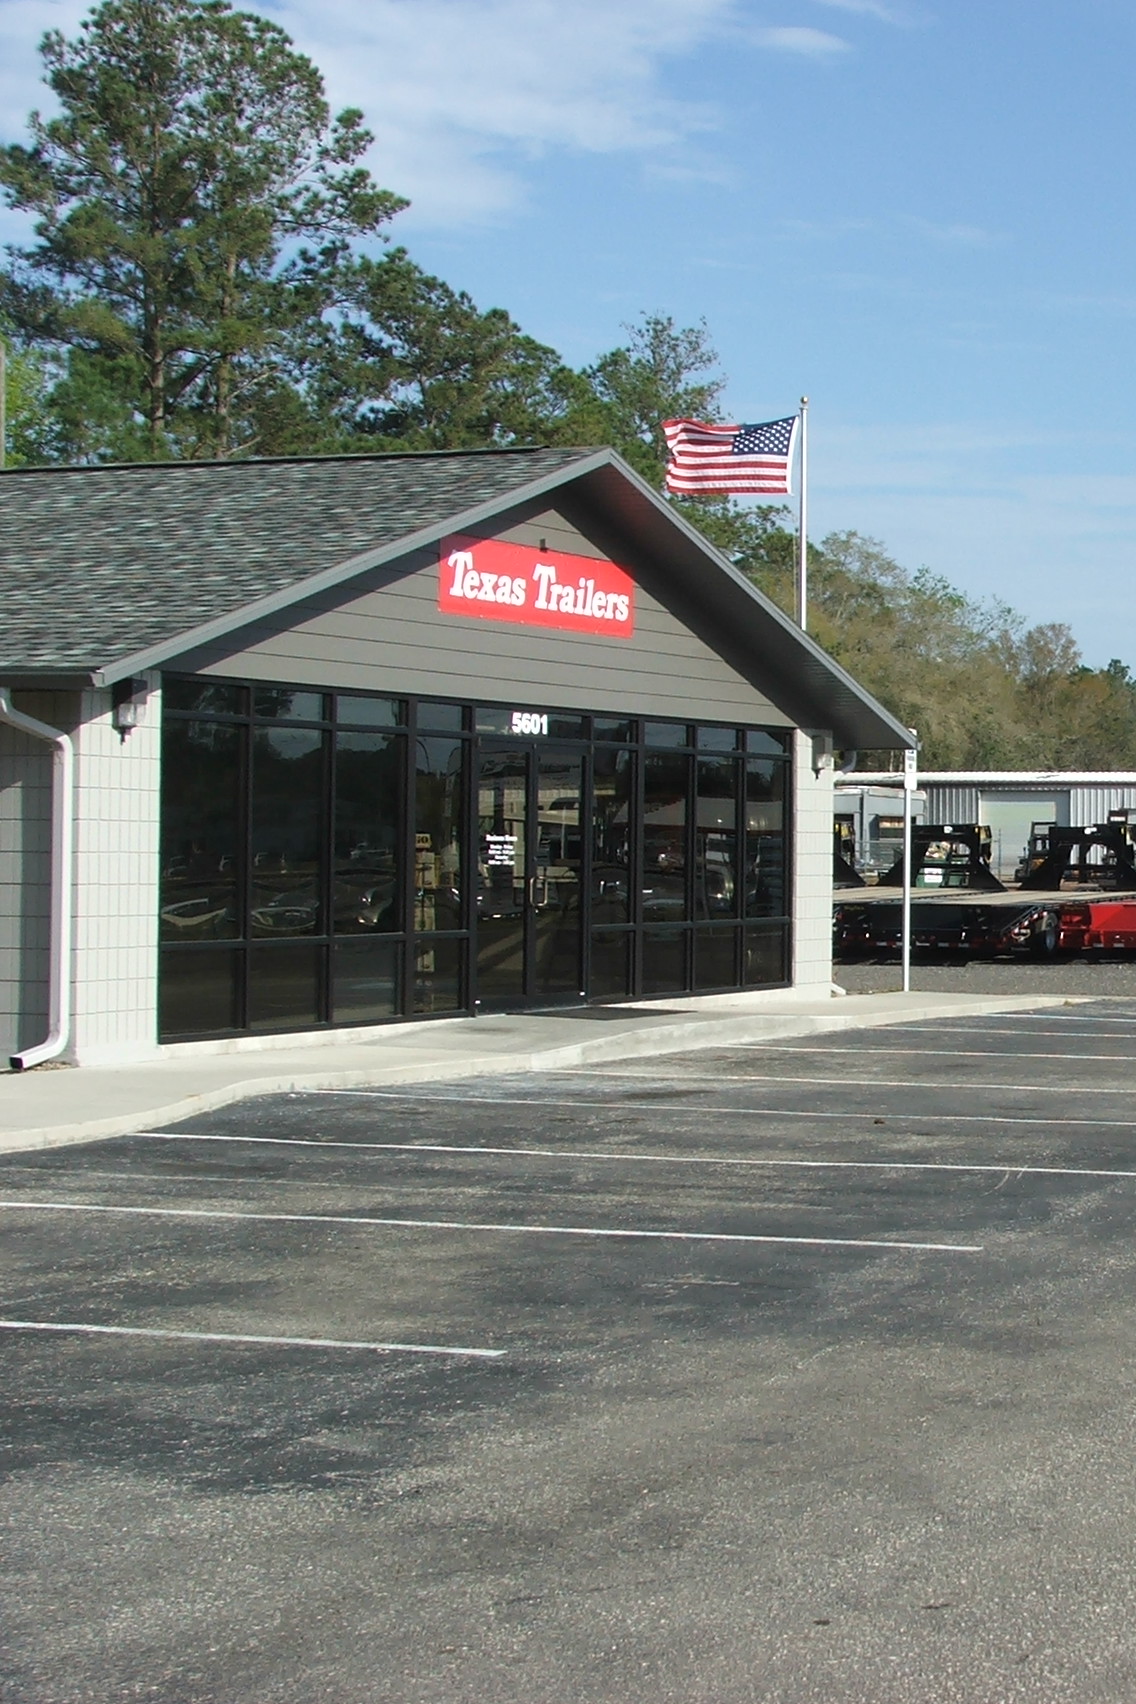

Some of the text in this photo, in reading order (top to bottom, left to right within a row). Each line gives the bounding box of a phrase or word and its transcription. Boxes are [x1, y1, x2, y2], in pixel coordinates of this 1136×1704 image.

[448, 551, 629, 621] Texas Trailers
[512, 712, 548, 735] 5601
